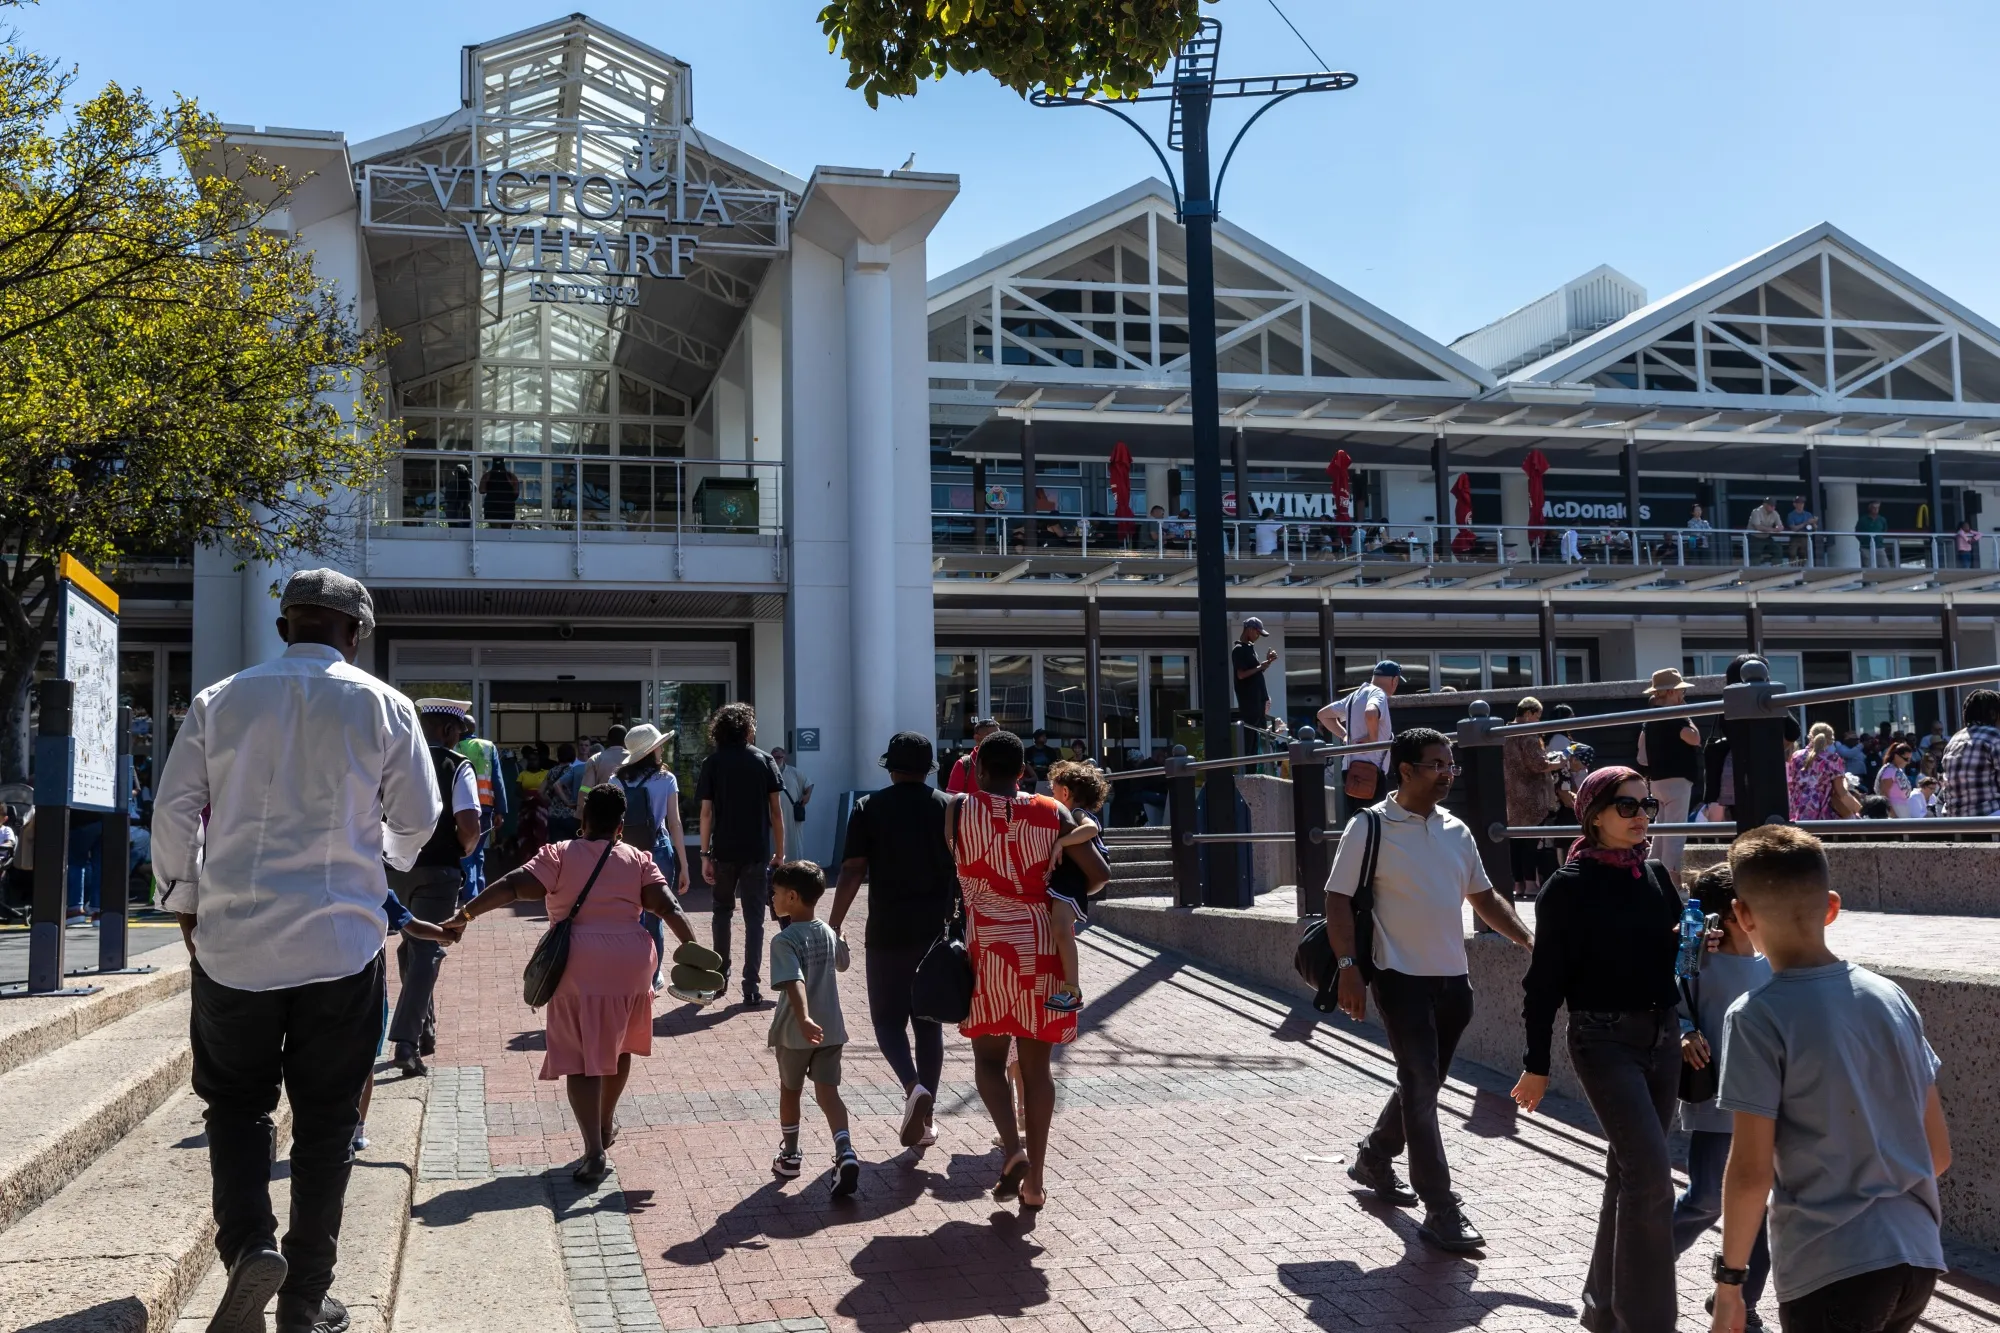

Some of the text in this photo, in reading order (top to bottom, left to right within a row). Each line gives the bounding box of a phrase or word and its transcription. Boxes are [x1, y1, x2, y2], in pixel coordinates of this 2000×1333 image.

[421, 164, 734, 228] VICTORIA
[460, 222, 699, 279] WHARF
[1251, 492, 1354, 518] WIMP
